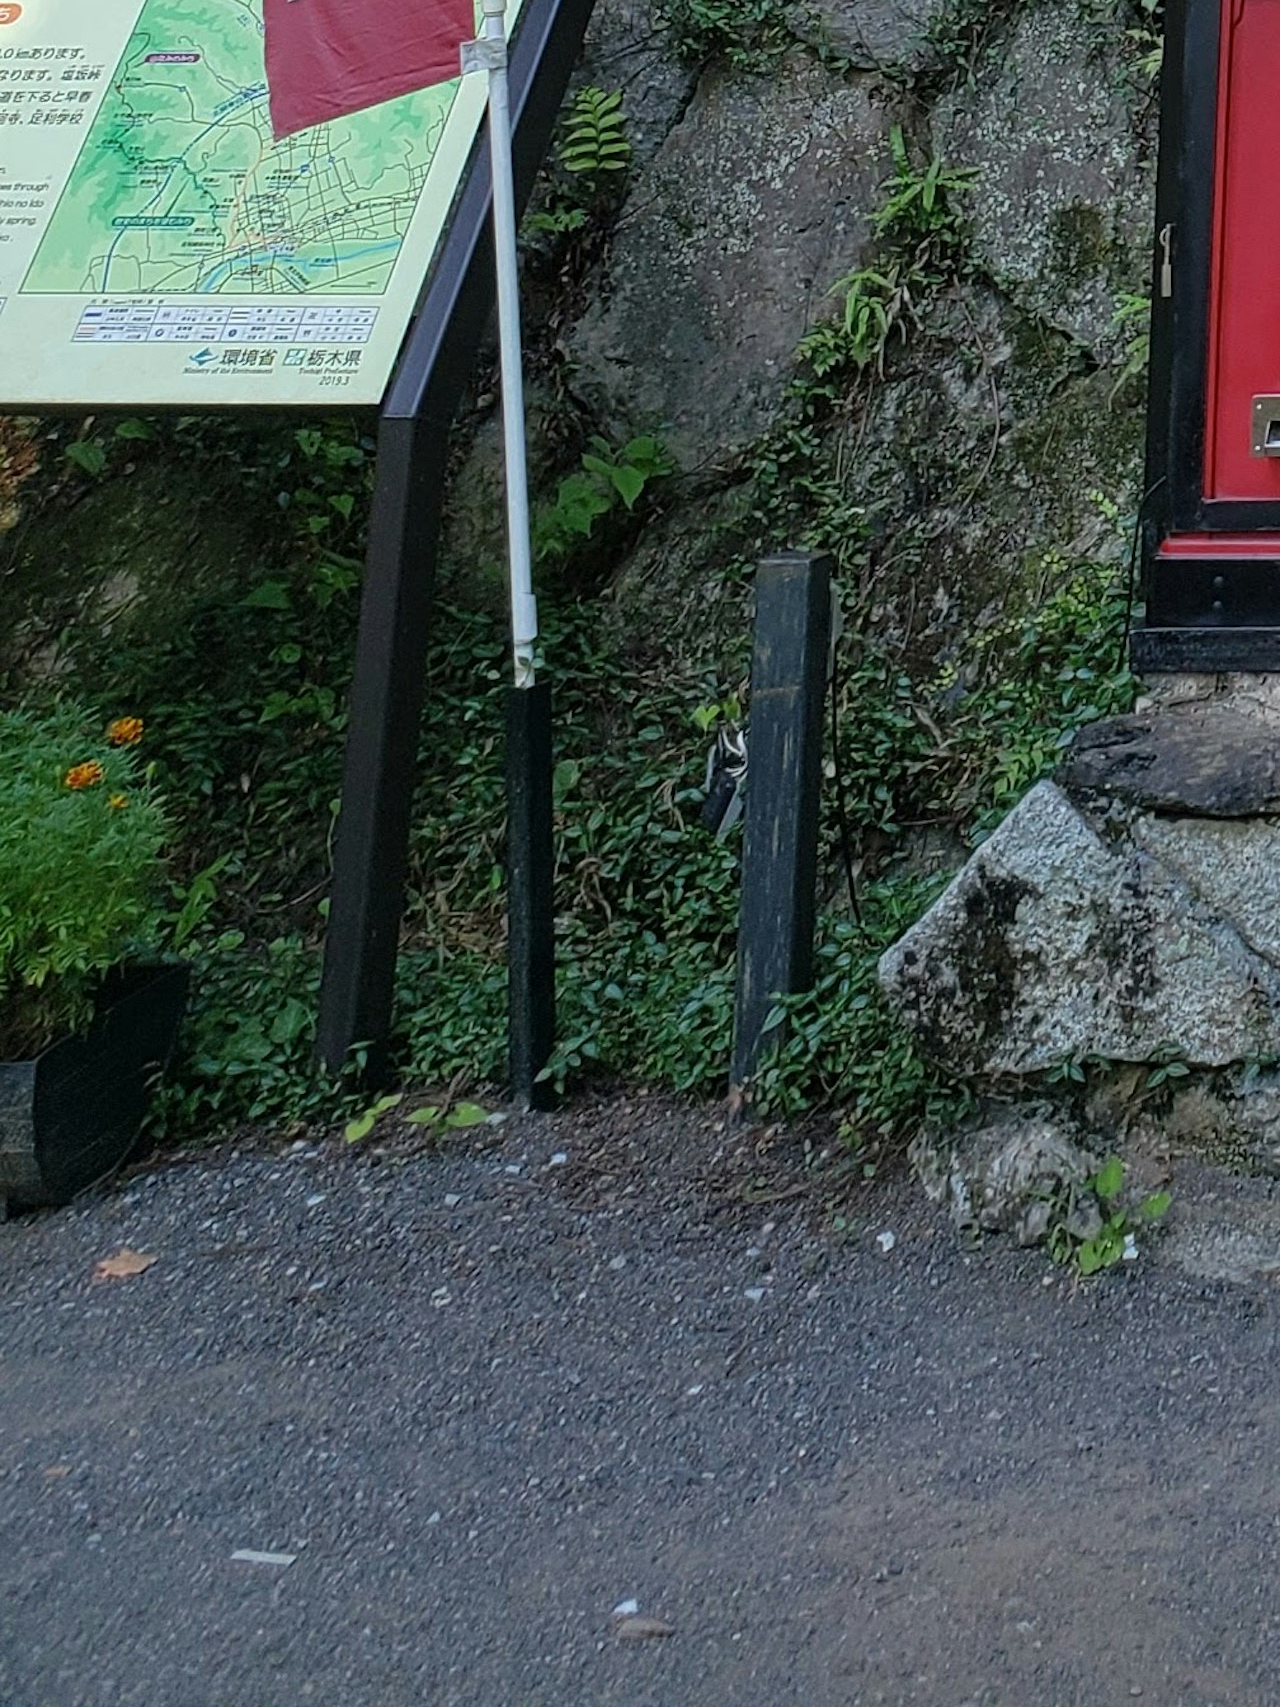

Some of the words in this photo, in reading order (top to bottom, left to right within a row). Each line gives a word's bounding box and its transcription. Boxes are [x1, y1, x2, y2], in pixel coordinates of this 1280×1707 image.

[219, 348, 278, 367] 環境省
[306, 349, 362, 367] 栃木県
[318, 376, 350, 386] 2019.3
